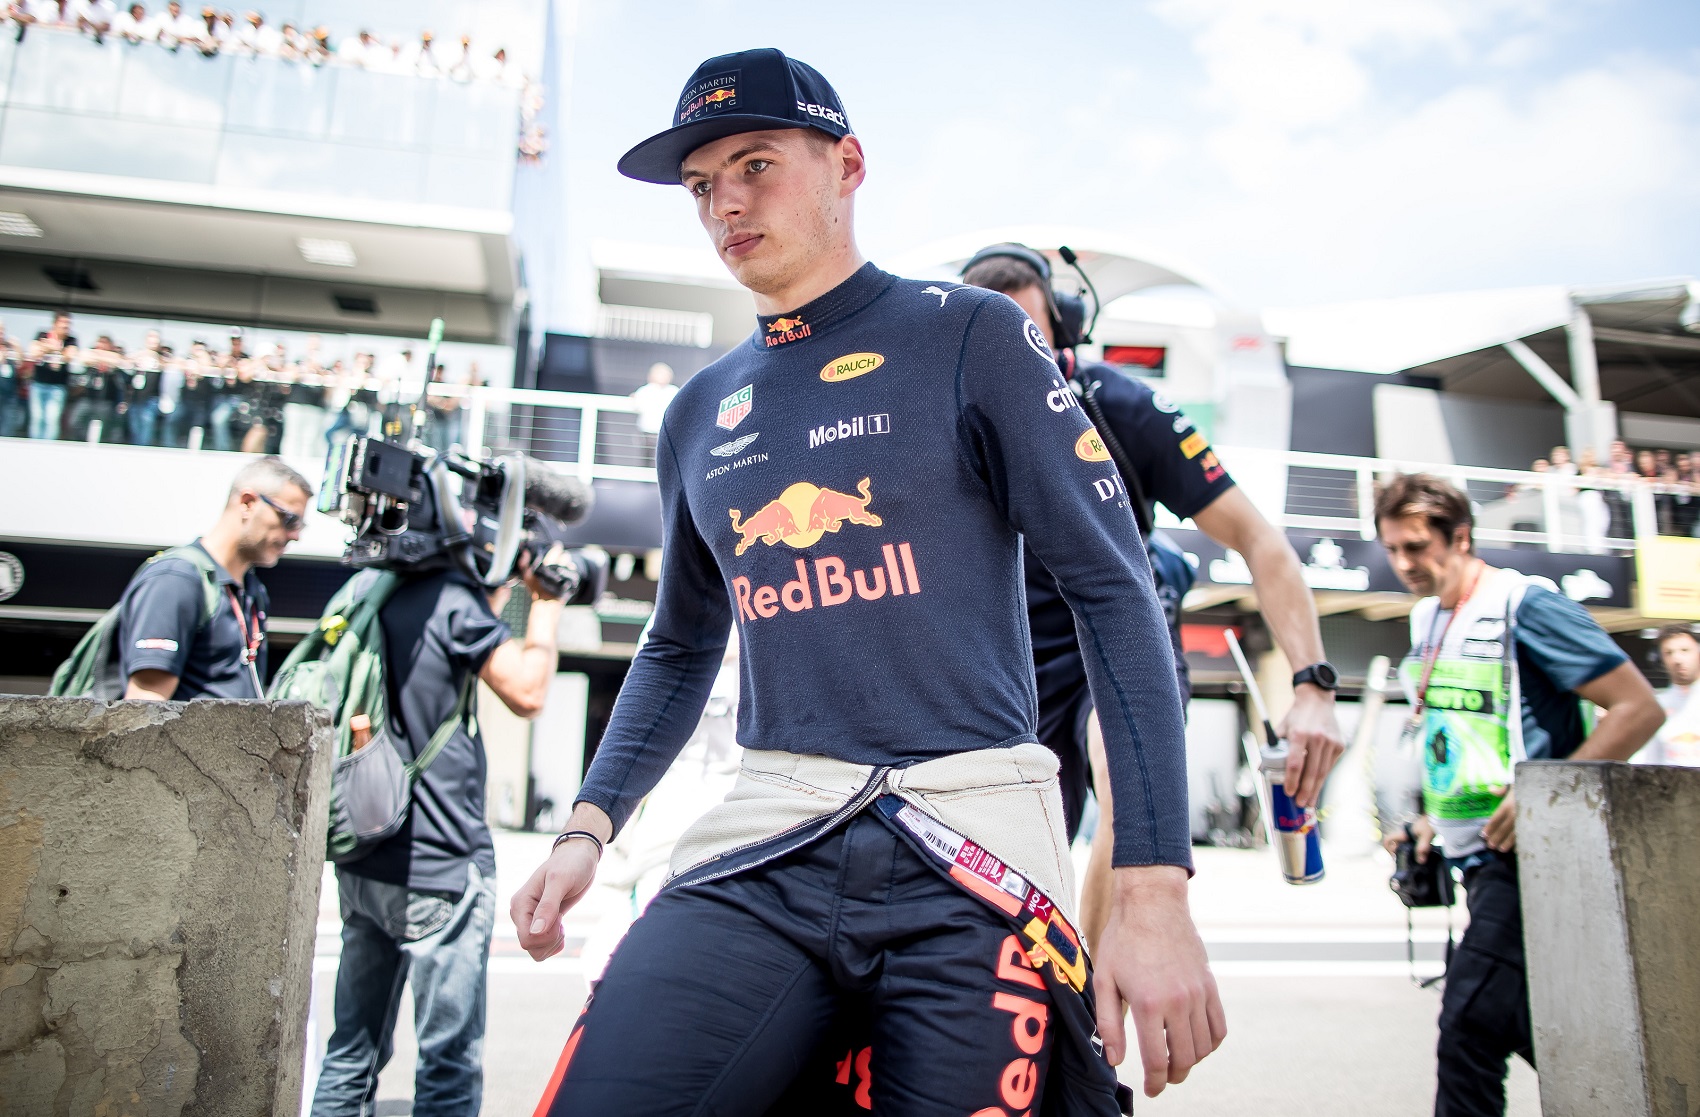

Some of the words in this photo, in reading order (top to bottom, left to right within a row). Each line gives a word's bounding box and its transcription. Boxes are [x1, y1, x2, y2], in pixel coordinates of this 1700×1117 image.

[699, 76, 736, 91] MARTIN
[681, 100, 736, 124] ACING
[836, 357, 876, 375] RAUCH
[722, 388, 750, 411] TAG
[719, 403, 750, 427] HEUER
[809, 417, 864, 449] Mobil
[705, 464, 730, 481] ASTON
[733, 452, 769, 470] MARTIN
